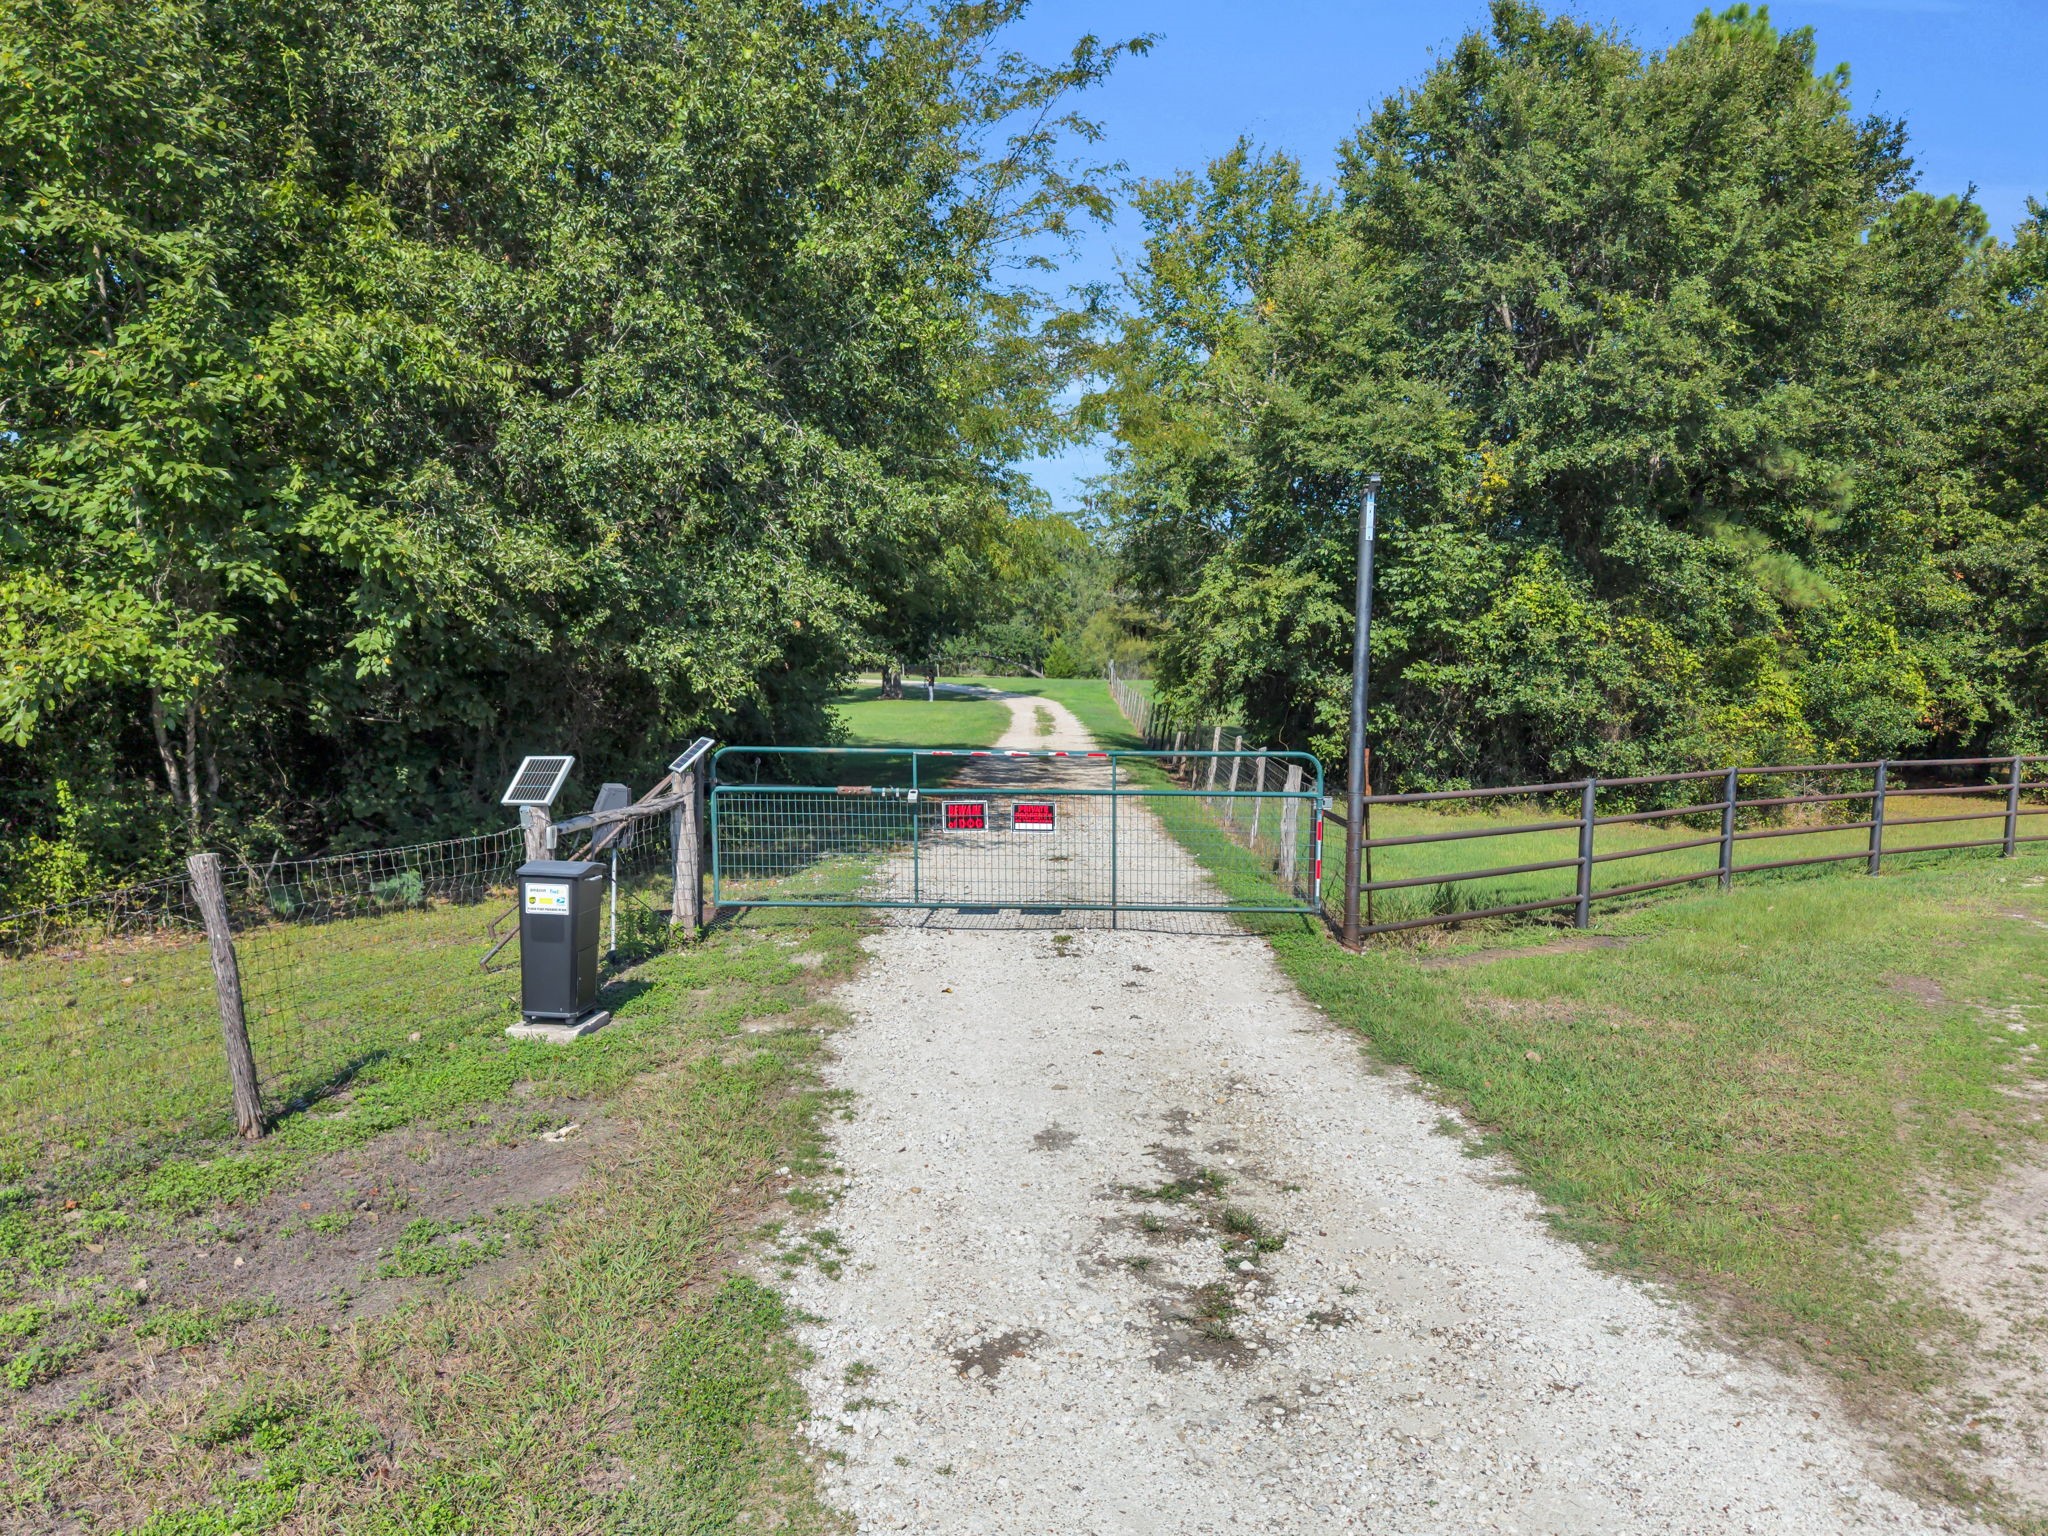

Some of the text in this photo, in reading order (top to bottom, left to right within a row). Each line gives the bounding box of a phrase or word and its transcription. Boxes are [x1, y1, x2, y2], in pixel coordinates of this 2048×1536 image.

[948, 804, 983, 816] BEWARE
[1018, 805, 1049, 813] PRIVATE
[959, 818, 984, 829] DOG
